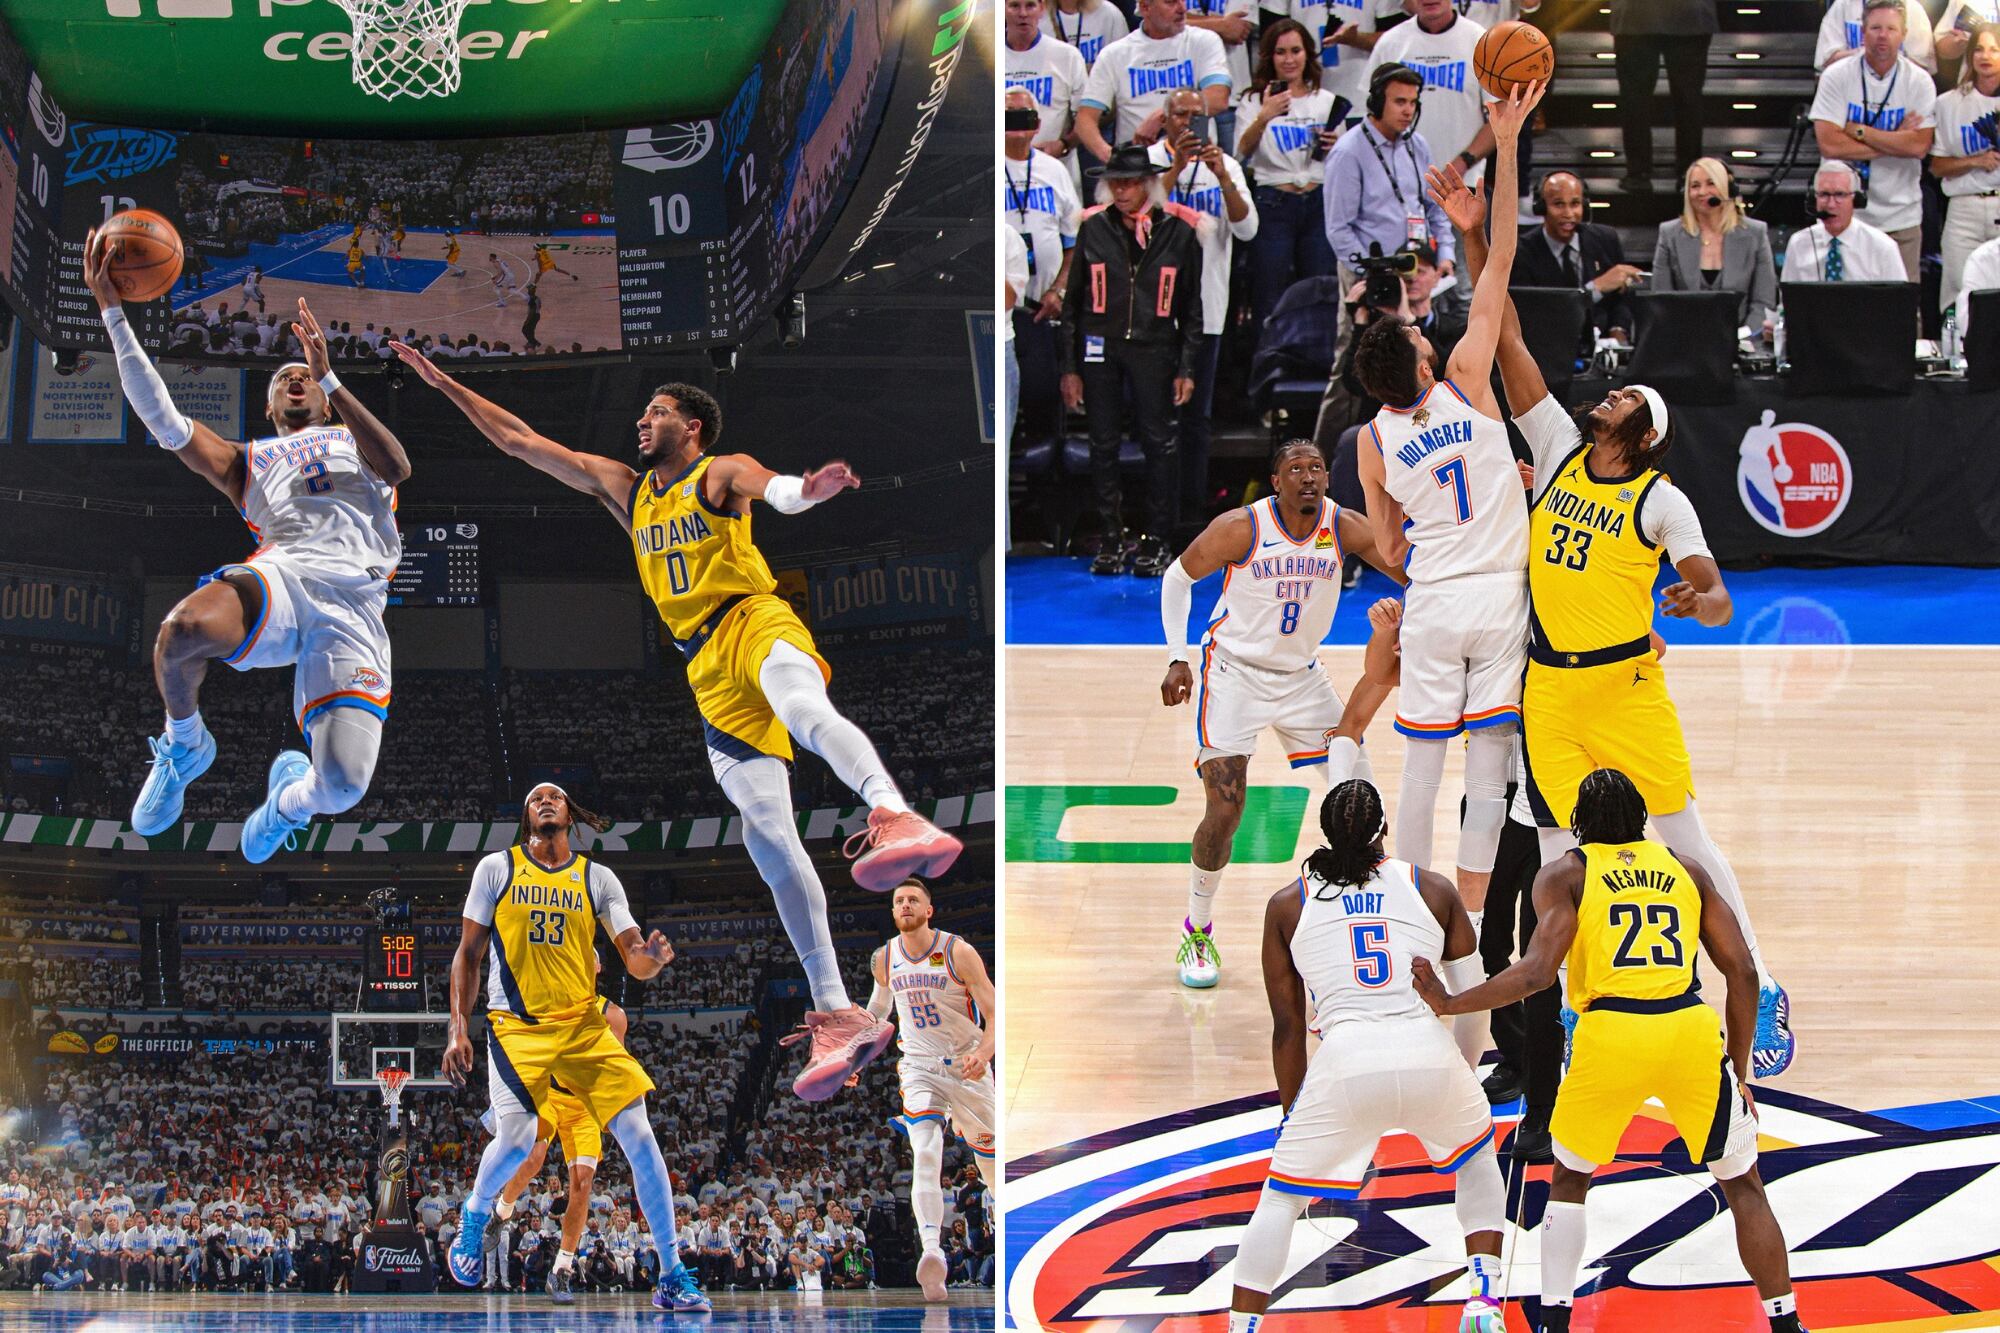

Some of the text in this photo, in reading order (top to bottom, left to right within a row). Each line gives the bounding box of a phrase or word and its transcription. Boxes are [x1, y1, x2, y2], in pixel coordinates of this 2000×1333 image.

[263, 29, 549, 62] center
[1128, 60, 1194, 99] THUNDER
[848, 45, 960, 253] paycom center
[32, 153, 49, 208] 10
[739, 153, 757, 206] 12
[648, 193, 691, 236] 10
[63, 242, 85, 251] PLAYE
[620, 240, 726, 258] PLAYER PTS FL
[619, 254, 725, 272] HALIBURTON 0 0
[60, 271, 80, 281] DORT
[620, 278, 648, 287] TOPPIN
[708, 271, 713, 279] 0
[621, 283, 728, 302] NEMBHARD 3 0
[58, 300, 88, 311] CARUSO
[622, 305, 662, 317] SHEPPARD
[710, 300, 716, 308] 0
[57, 315, 106, 328] HARTENSTEI
[623, 313, 730, 331] TURNER 3 0
[61, 331, 71, 340] TO
[86, 333, 96, 342] TF
[144, 338, 161, 348] 5:02
[629, 328, 728, 346] TO 7 TF 2 1ST 5:02
[43, 392, 114, 401] NORTHWEST
[49, 381, 111, 390] 2023-2024
[53, 402, 104, 411] DIVISION
[171, 393, 232, 402] ORTHWEST
[178, 402, 222, 412] IVISION
[43, 412, 113, 421] CHAMPIONS
[190, 413, 230, 422] MPIONS
[286, 442, 331, 467] CITY
[1396, 420, 1473, 469] HOLMGREN
[301, 460, 336, 495] 2
[1810, 462, 1838, 485] NBA
[1430, 454, 1474, 526] 7
[1783, 485, 1839, 502] ESPN
[1544, 486, 1626, 539] INDIANA
[425, 527, 447, 542] 10
[635, 510, 713, 557] INDIANA
[1545, 522, 1593, 572] 33
[665, 550, 691, 597] 0
[1251, 556, 1338, 580] OKLAHOMA
[816, 568, 887, 621] LOUD
[896, 566, 958, 608] CITY
[1275, 580, 1314, 600] CITY
[2, 583, 54, 621] OUD
[967, 585, 980, 621] 303
[1280, 600, 1303, 637] 8
[130, 618, 140, 653] 330
[868, 623, 948, 641] EXIT NOW
[1601, 869, 1676, 894] NESMITH
[511, 885, 583, 913] INDIANA
[1341, 892, 1385, 916] DORT
[190, 925, 364, 937] RIVERWIND CASINO
[529, 909, 567, 947] 33
[679, 917, 779, 934] RIVERWIND
[1609, 903, 1685, 968] 23
[382, 936, 415, 951] 5:02
[1348, 921, 1393, 989] 5
[387, 951, 412, 977] 10
[383, 982, 418, 990] TISSOT
[891, 972, 948, 991] OKLAHOMA
[911, 1003, 942, 1029] 55
[122, 1039, 143, 1052] THE
[146, 1039, 193, 1053] OFFICIA
[377, 1246, 423, 1272] Finals
